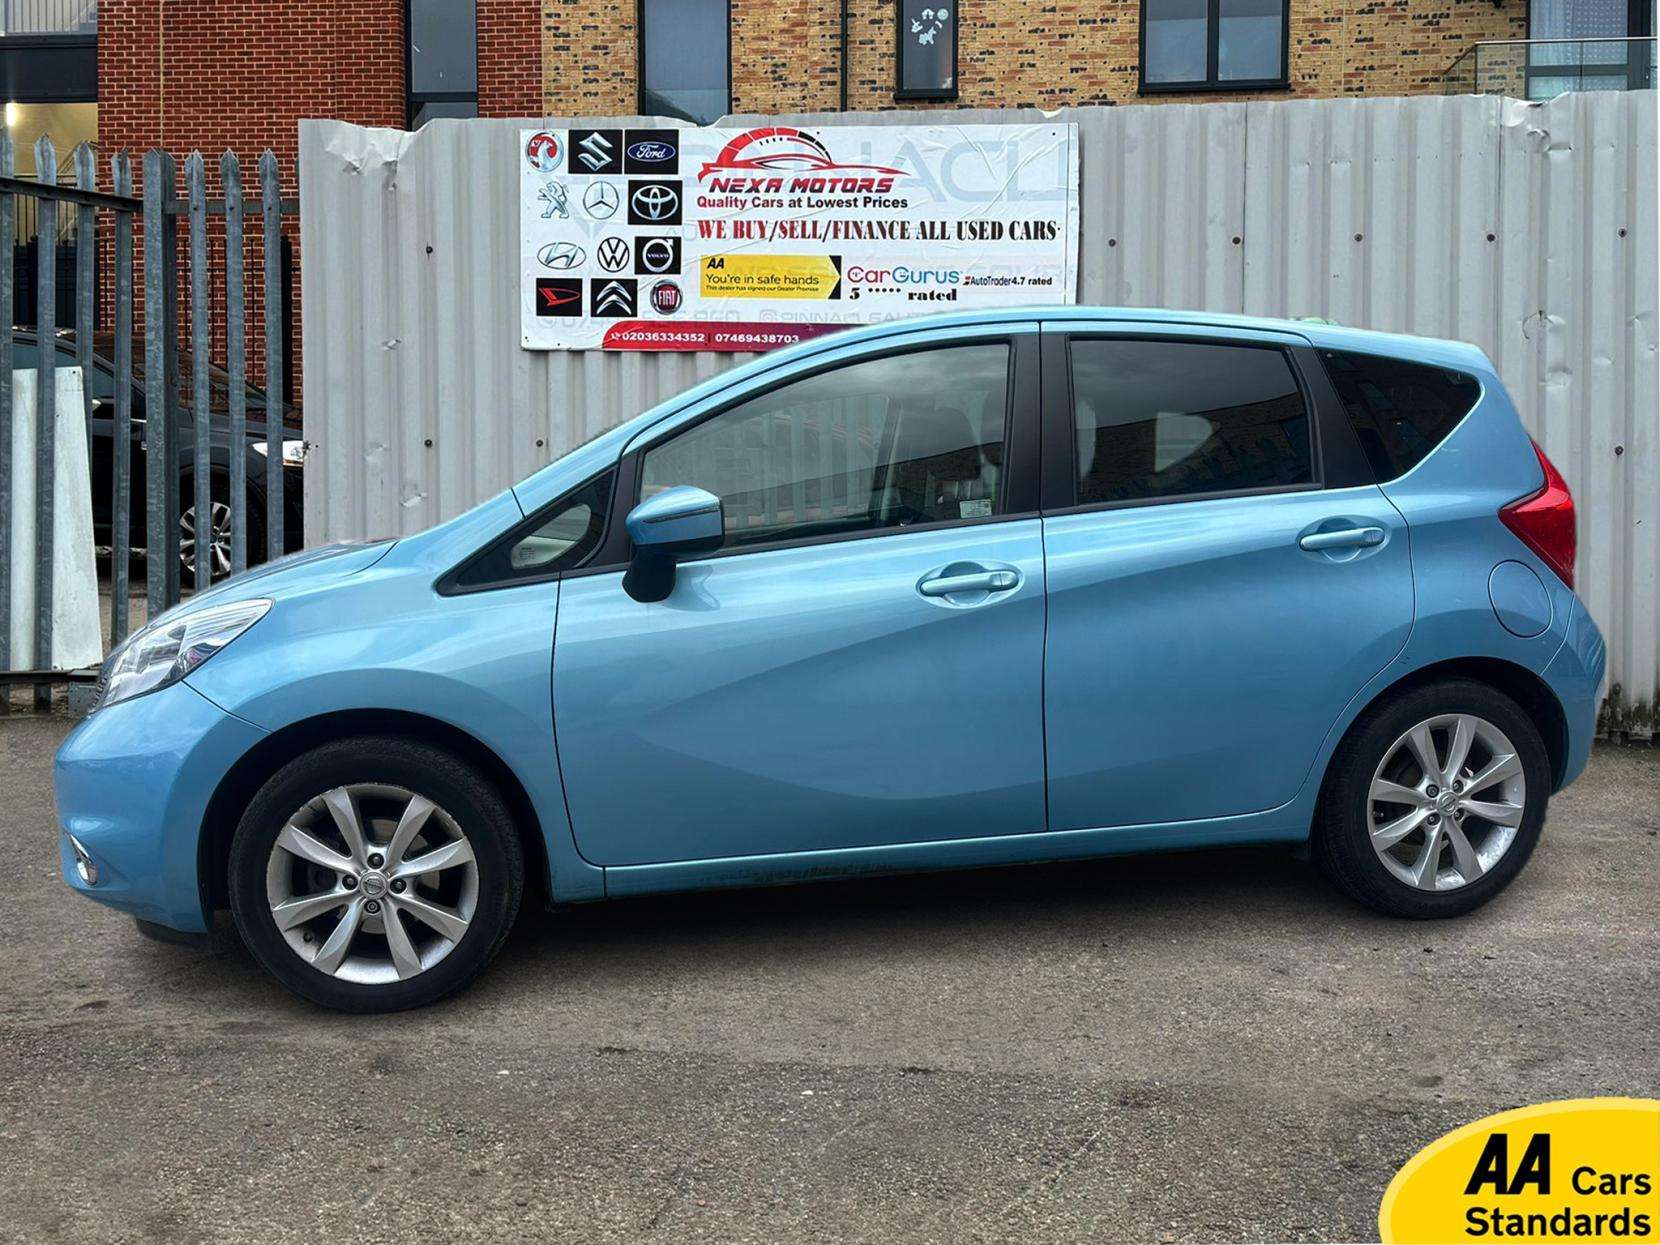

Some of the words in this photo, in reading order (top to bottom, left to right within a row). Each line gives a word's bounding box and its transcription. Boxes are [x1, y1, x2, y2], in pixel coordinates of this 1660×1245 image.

[636, 144, 666, 159] Ford
[708, 178, 784, 193] NEXA
[789, 178, 894, 194] MOTORS
[697, 196, 747, 211] Quality
[751, 196, 784, 208] Cars
[788, 197, 802, 208] at
[807, 197, 857, 208] Lowest
[863, 196, 908, 208] Prices
[697, 220, 727, 240] WE
[916, 221, 951, 240] ALL
[956, 221, 1004, 241] USED
[1009, 221, 1057, 241] CARS
[707, 257, 724, 269] AA
[706, 274, 741, 284] You're
[744, 274, 754, 284] in
[757, 274, 781, 284] safe
[784, 275, 819, 285] hands
[1028, 277, 1053, 285] rated
[658, 290, 676, 305] FIAT
[849, 287, 860, 300] 5
[908, 288, 958, 301] rated
[622, 332, 705, 342] 02036334352
[714, 333, 800, 344] 07469438703
